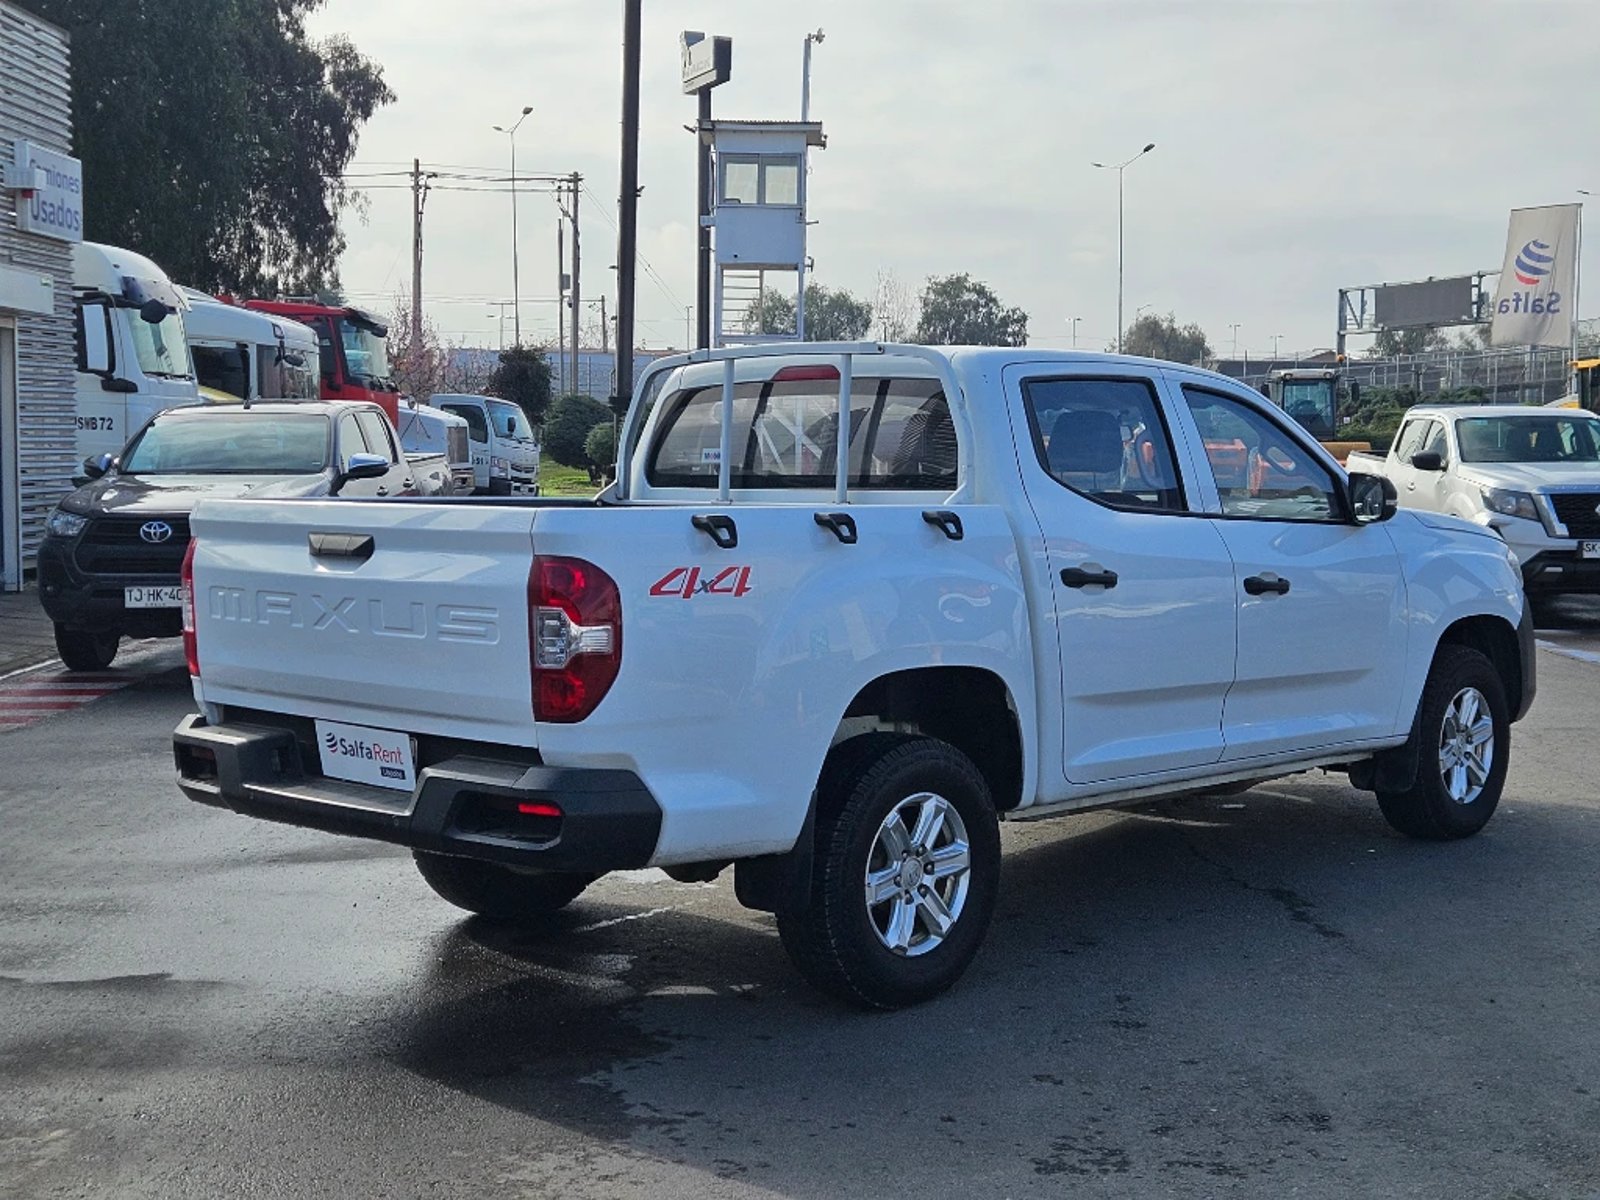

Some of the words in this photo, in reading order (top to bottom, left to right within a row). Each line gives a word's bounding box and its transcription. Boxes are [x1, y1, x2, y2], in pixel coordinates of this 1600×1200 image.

[31, 191, 79, 231] Usados
[649, 566, 752, 599] 4x4
[209, 586, 500, 645] MAXUS
[339, 737, 404, 765] SalfaRent
